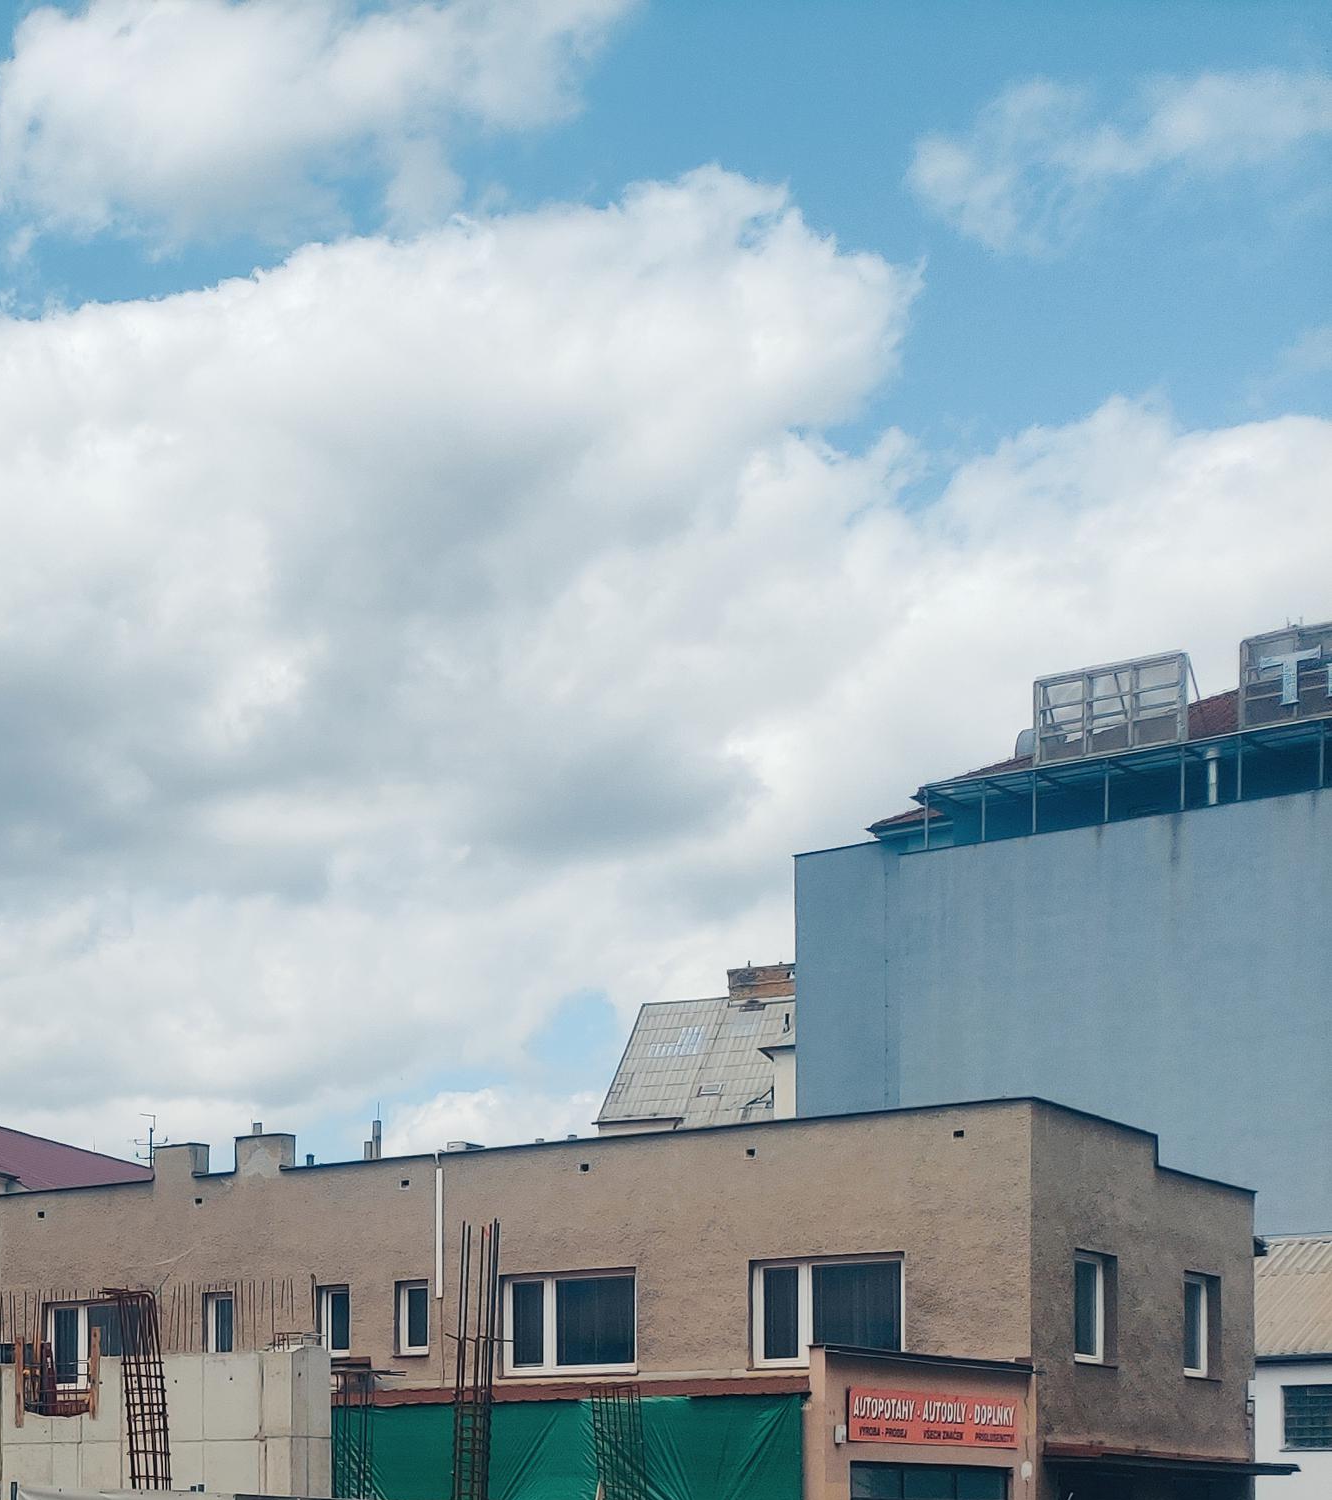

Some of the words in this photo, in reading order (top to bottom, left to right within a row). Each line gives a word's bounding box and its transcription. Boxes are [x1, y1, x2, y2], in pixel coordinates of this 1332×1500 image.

[1259, 645, 1332, 705] T
[853, 1396, 915, 1422] AUTOPOTAHY
[922, 1398, 968, 1424] AUTODÍLY
[974, 1402, 1016, 1427] DOPLŇKY
